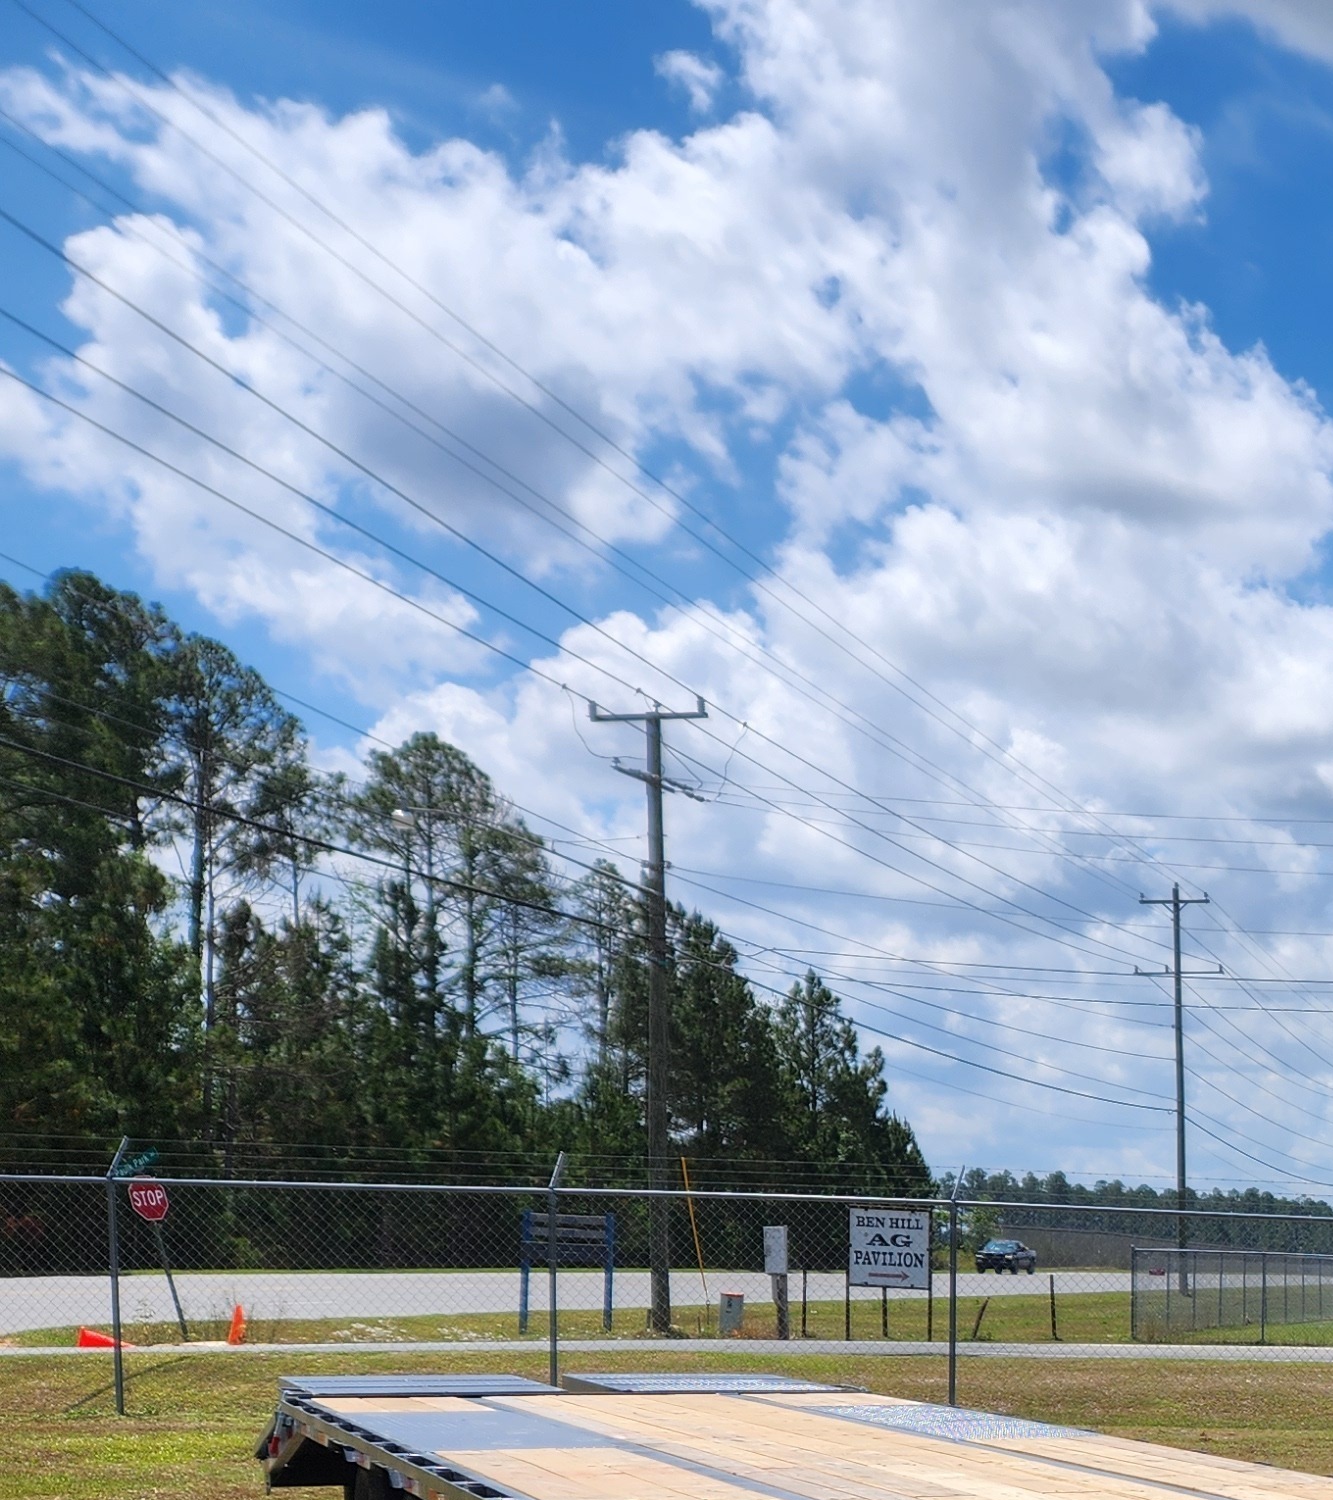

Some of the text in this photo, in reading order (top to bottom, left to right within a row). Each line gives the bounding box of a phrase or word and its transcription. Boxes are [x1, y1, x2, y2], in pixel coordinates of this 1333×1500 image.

[132, 1189, 163, 1207] STOP
[856, 1215, 923, 1231] BEN HILL
[866, 1232, 913, 1248] AG
[854, 1250, 925, 1268] PAVILION
